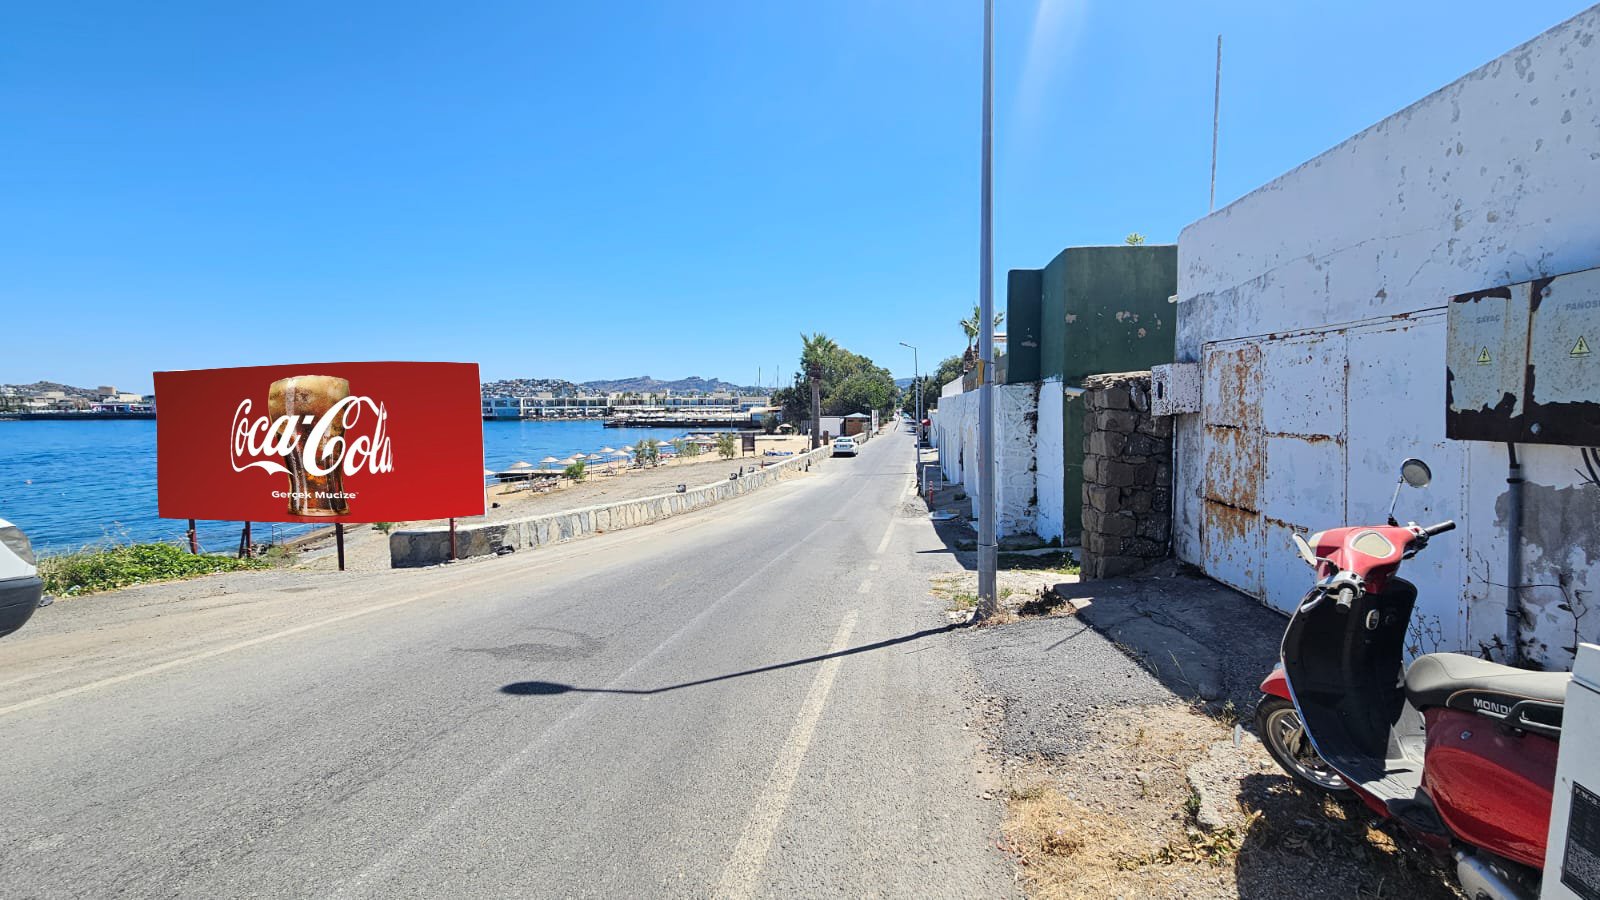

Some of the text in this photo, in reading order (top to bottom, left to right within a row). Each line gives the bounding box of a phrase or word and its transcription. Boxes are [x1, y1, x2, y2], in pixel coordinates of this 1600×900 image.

[230, 395, 393, 477] Coca-Cola
[271, 490, 312, 500] Gerçek
[1473, 697, 1529, 721] MONDIL
